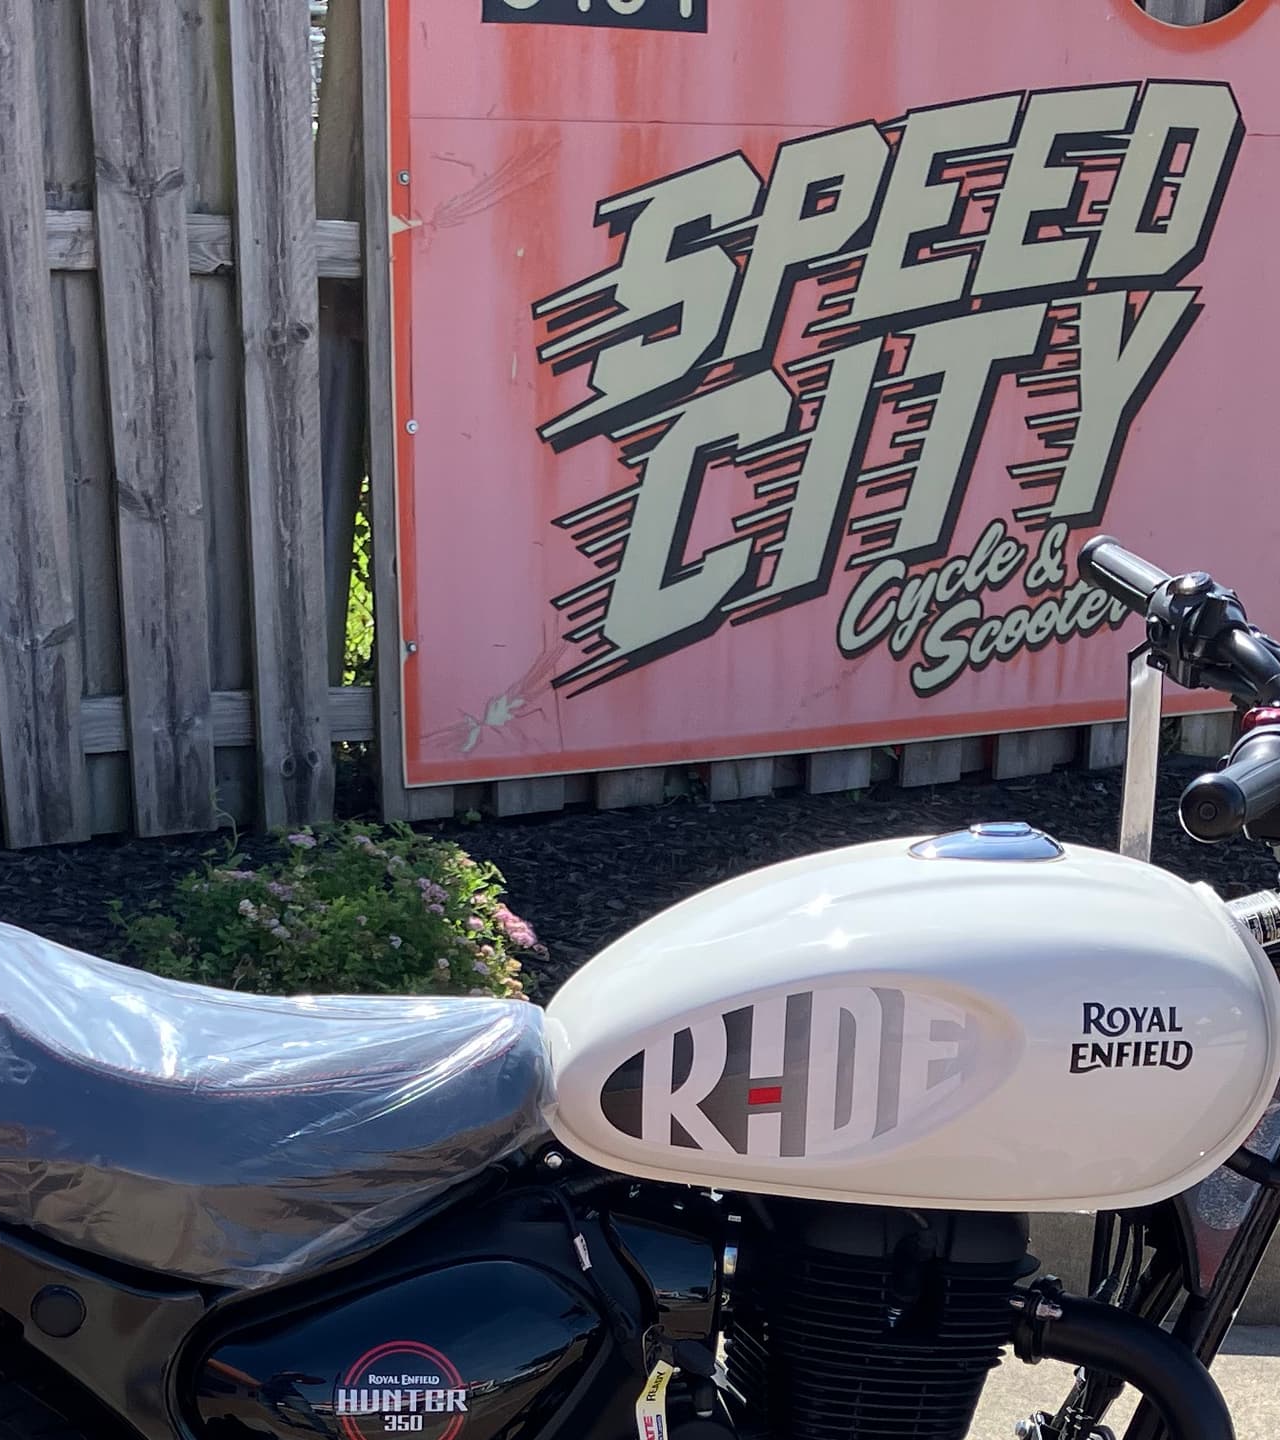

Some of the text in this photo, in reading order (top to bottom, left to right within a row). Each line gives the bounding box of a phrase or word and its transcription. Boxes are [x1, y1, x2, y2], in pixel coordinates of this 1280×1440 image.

[535, 78, 1246, 445] SPEED
[552, 289, 1204, 690] CITY
[837, 518, 1069, 660] Cycle &
[910, 578, 1128, 698] Scooter
[1082, 1001, 1184, 1037] ROYAL
[1069, 1040, 1194, 1074] ENFIELD
[368, 1374, 440, 1386] ROYAL ENFIELD
[646, 1371, 666, 1402] READY
[337, 1388, 469, 1412] HUNTER
[383, 1415, 423, 1432] 350
